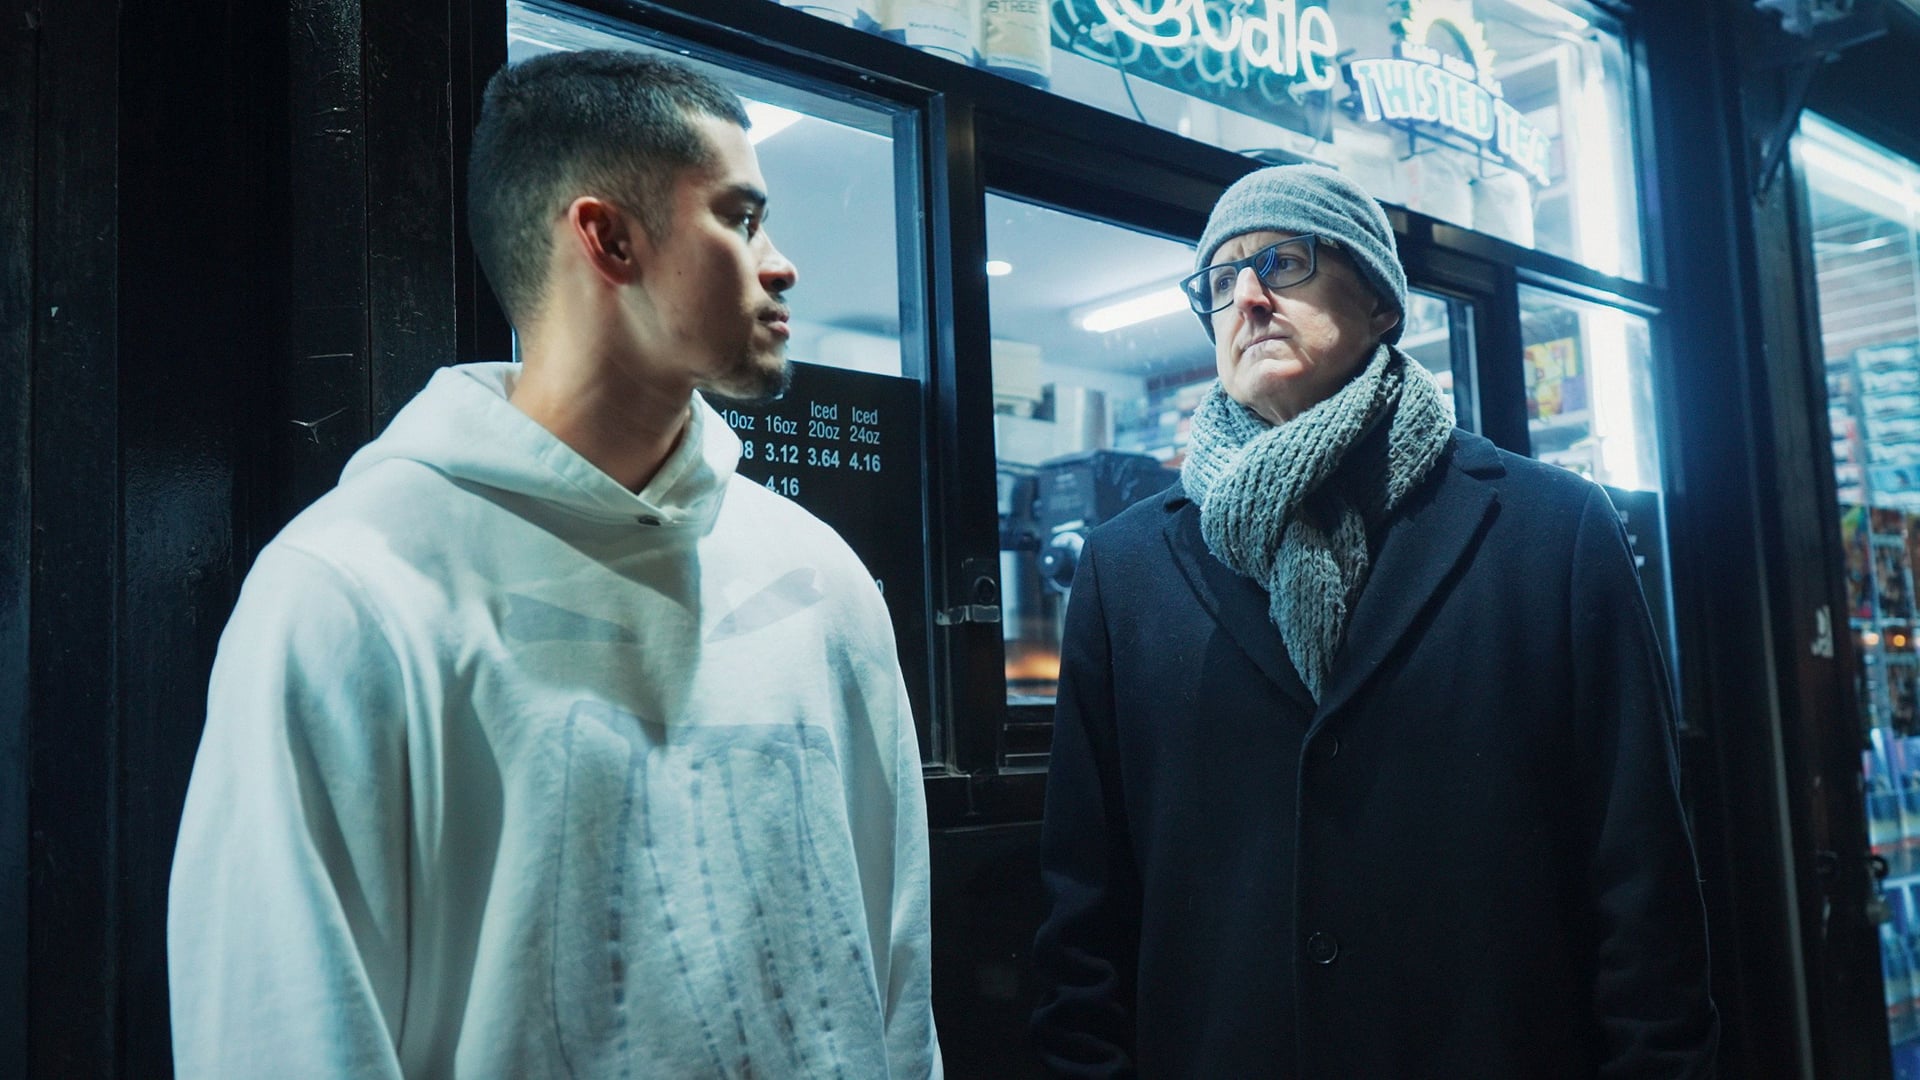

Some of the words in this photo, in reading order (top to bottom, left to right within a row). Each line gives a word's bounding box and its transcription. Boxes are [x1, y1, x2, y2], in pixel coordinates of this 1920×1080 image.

[1350, 58, 1496, 141] TWISTED
[721, 409, 755, 430] 10oz
[765, 415, 798, 436] 16oz
[808, 420, 840, 440] 20oz
[849, 425, 880, 445] 24oz
[810, 401, 838, 420] Iced
[852, 406, 878, 425] Iced
[764, 443, 799, 464] 3.12
[807, 447, 840, 469] 3.64
[849, 452, 881, 473] 4.16
[765, 475, 800, 497] 4.16
